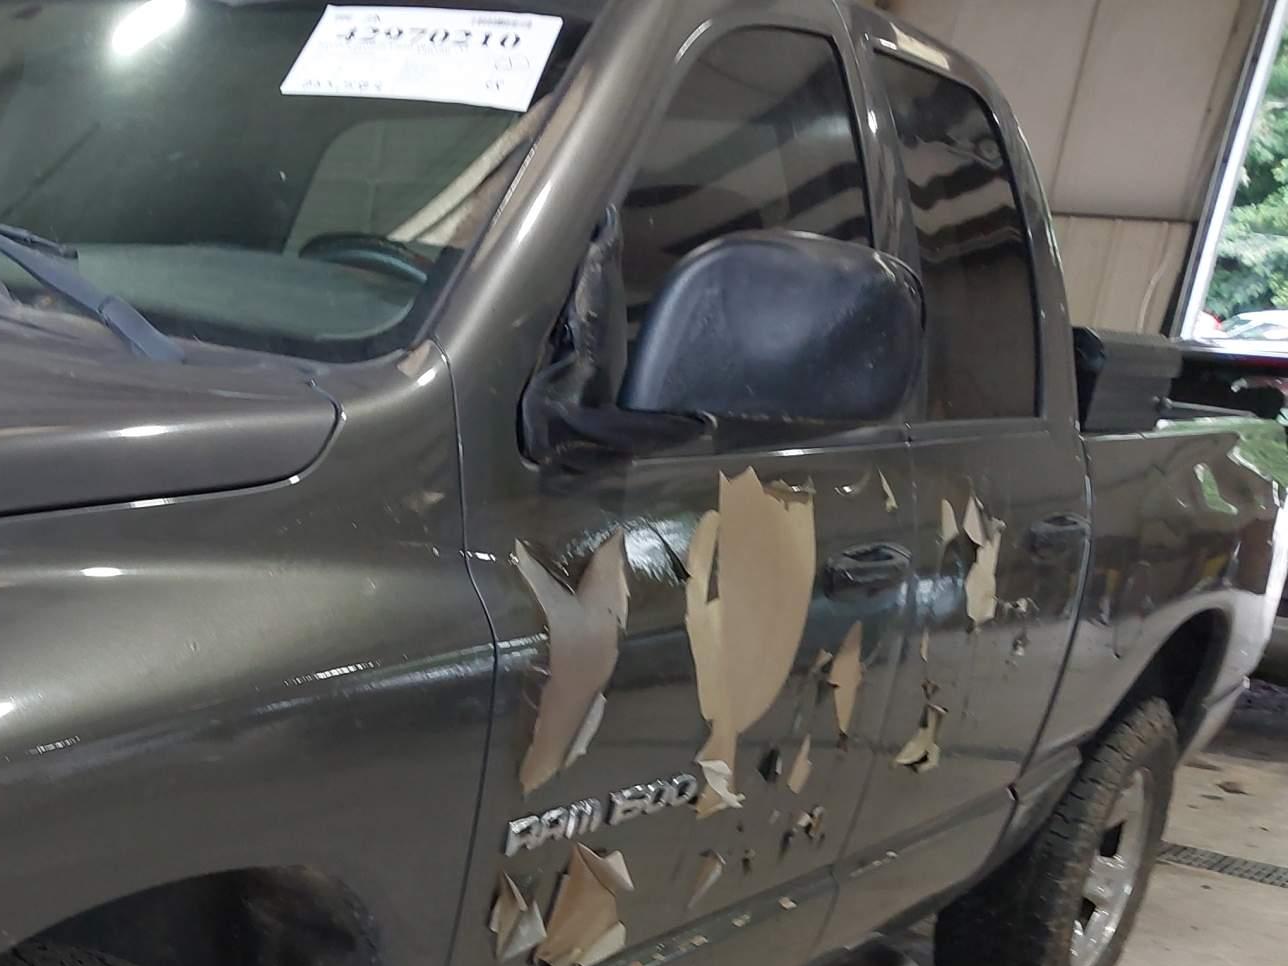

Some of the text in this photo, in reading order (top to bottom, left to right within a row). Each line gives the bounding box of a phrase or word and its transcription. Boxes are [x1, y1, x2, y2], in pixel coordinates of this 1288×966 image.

[336, 25, 522, 49] 42970210
[505, 772, 699, 857] RAM 1500
